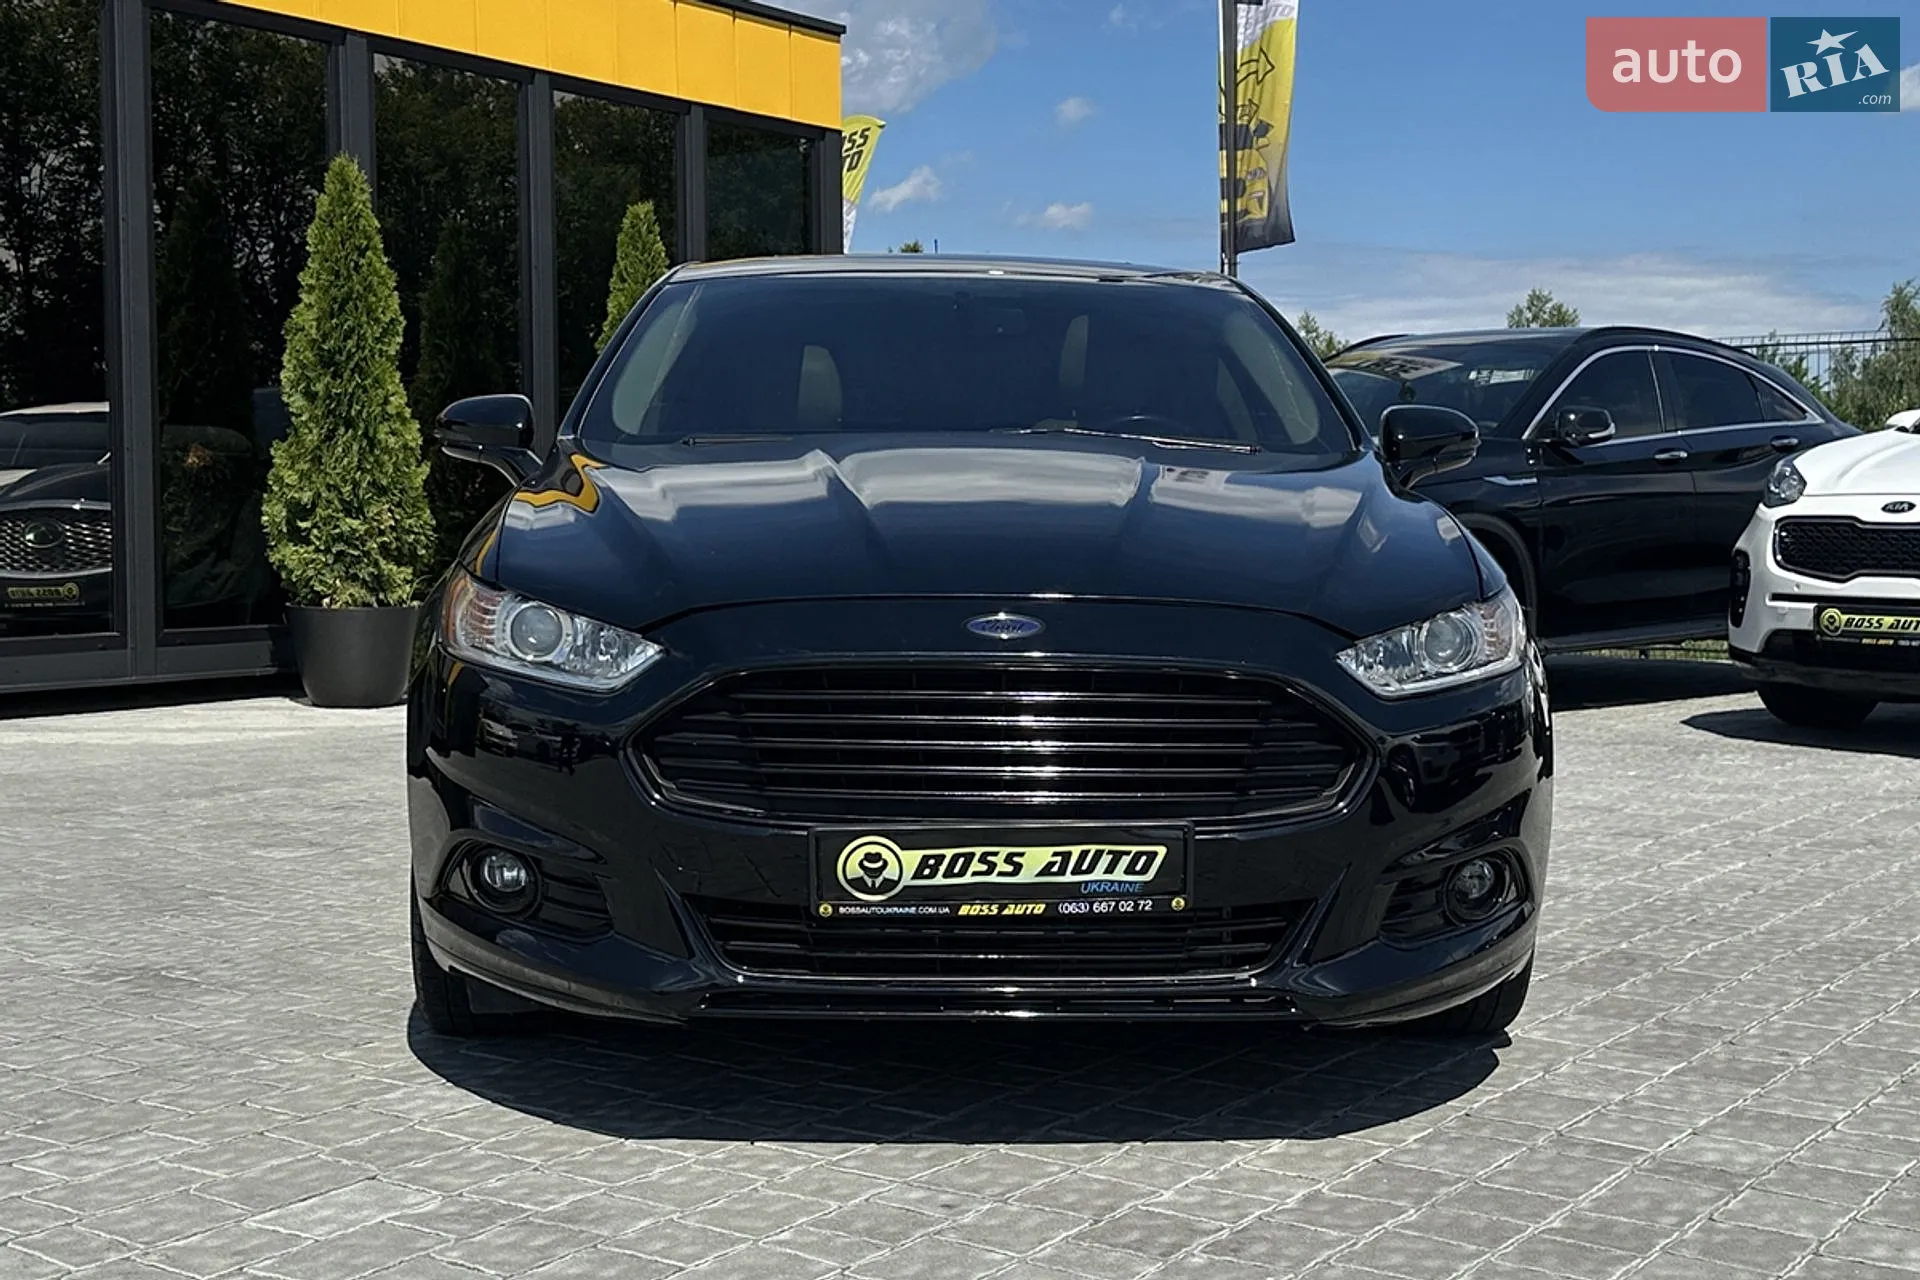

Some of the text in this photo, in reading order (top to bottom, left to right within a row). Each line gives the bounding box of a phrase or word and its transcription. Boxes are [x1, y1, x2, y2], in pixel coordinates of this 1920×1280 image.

[1844, 616, 1885, 629] BOSS
[910, 848, 1159, 880] BOSS AUTO
[1080, 881, 1145, 893] UKRAINE
[957, 903, 1046, 916] BOSS AUTO
[1058, 899, 1153, 914] (063) 667 02 72
